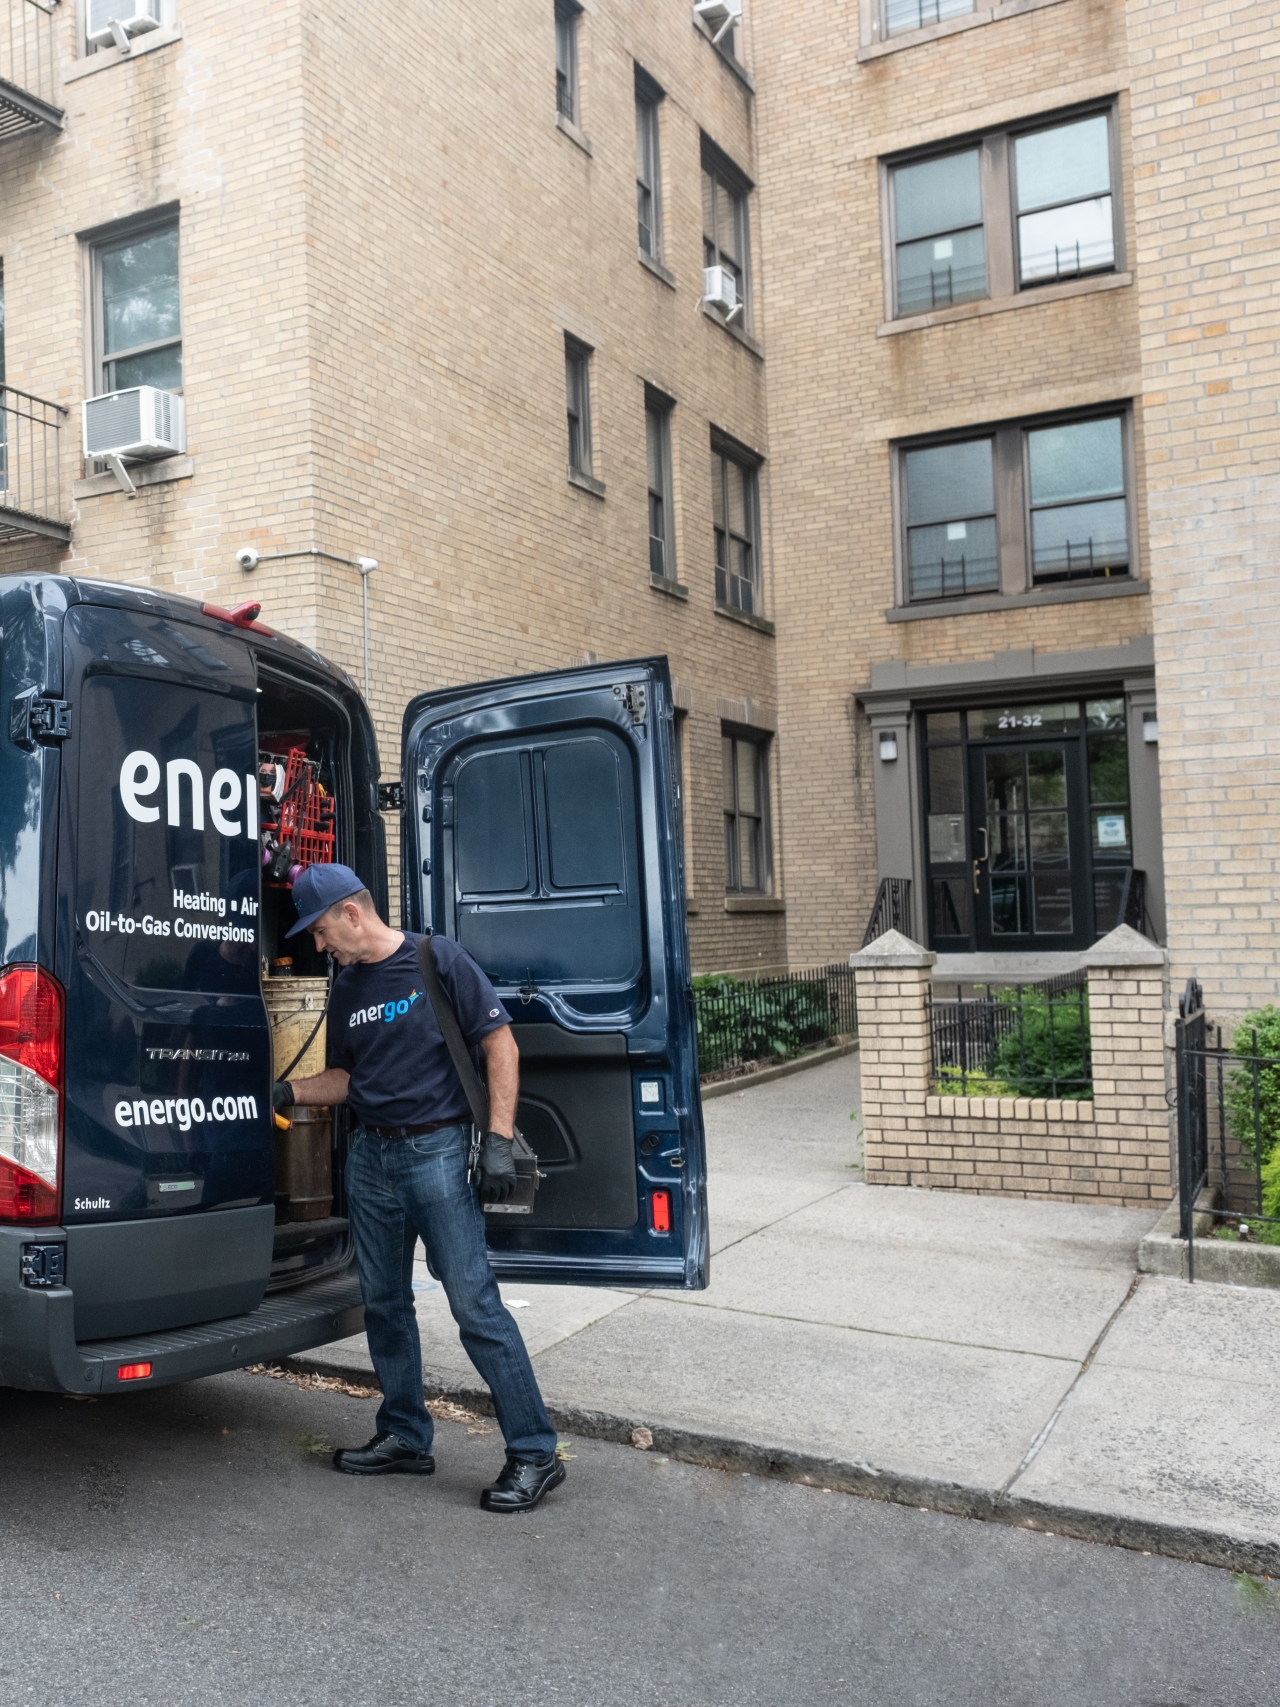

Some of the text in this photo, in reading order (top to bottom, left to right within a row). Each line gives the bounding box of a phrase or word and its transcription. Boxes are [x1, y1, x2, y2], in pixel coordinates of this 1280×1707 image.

[998, 714, 1043, 728] 21-32
[173, 889, 259, 917] Heating Air
[85, 910, 256, 943] Oil-to-Gas Conversions
[349, 999, 409, 1028] energo
[146, 1048, 228, 1060] TRANSIT
[114, 1095, 258, 1131] energo.com
[74, 1197, 111, 1210] Schultz
